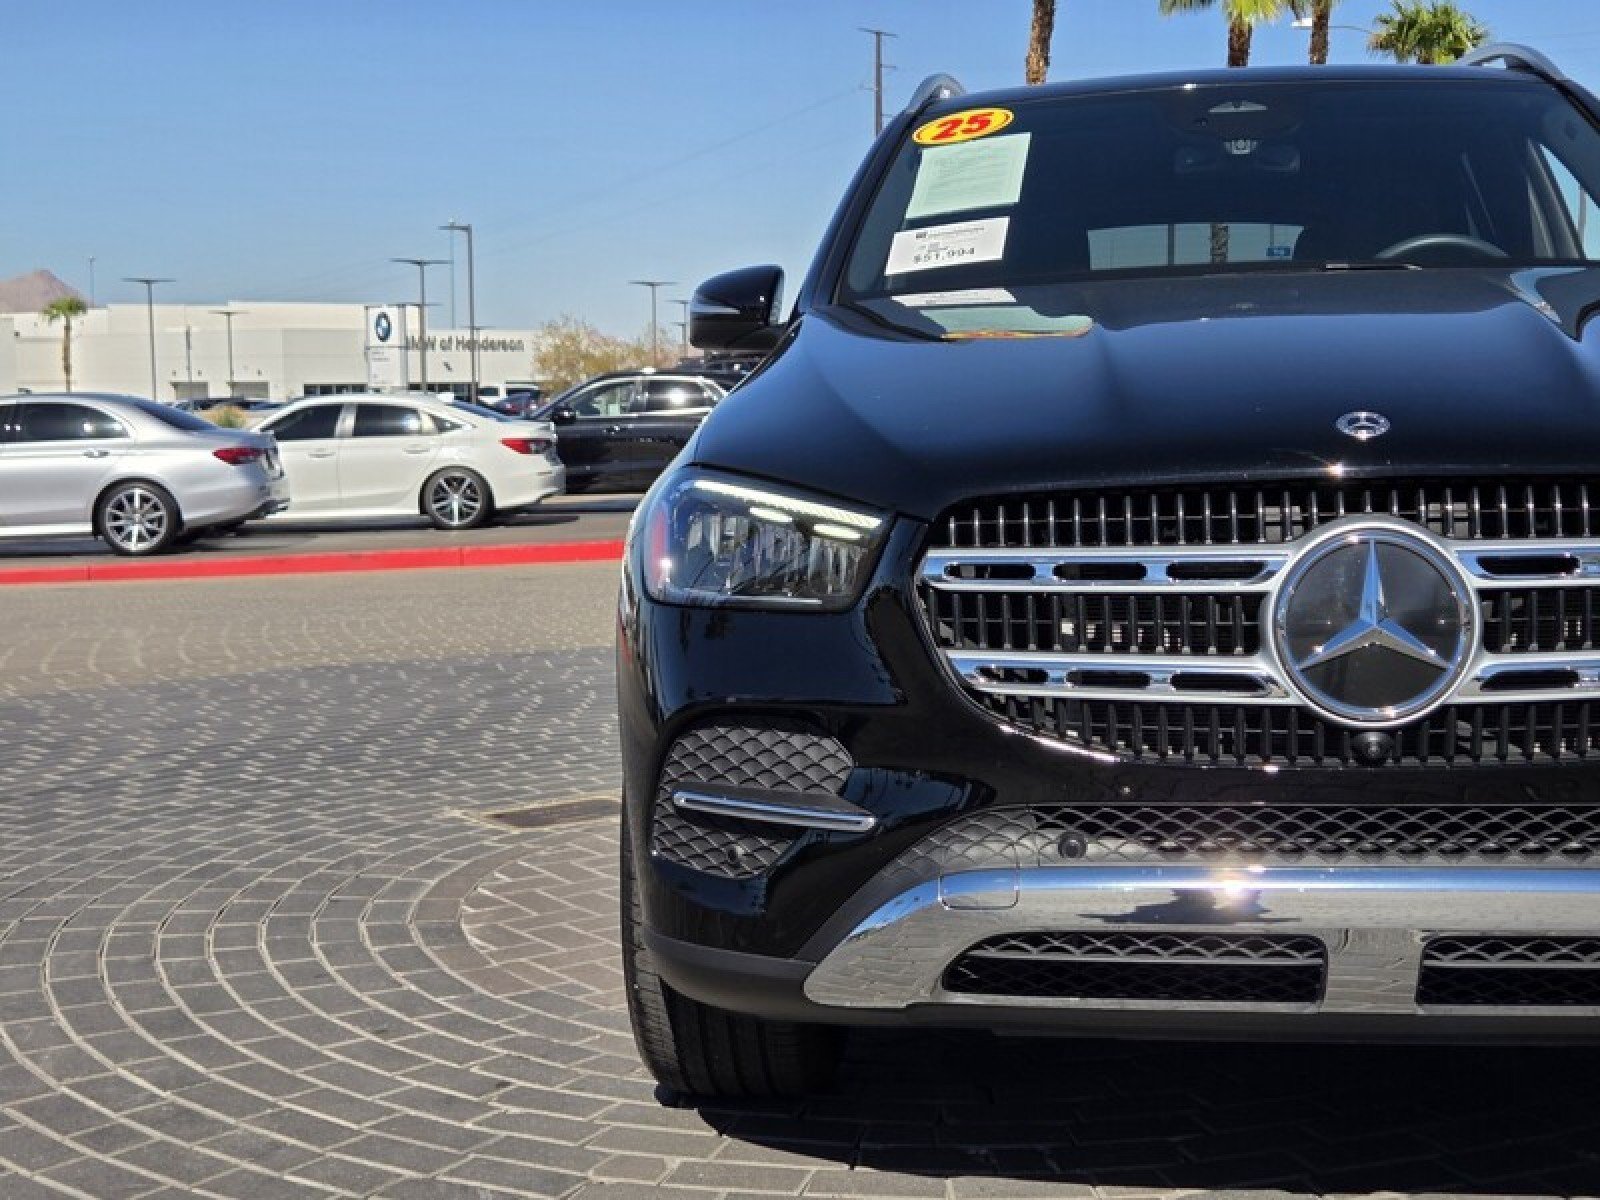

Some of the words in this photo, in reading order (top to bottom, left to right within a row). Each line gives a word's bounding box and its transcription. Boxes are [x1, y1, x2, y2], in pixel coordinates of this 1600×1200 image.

[930, 111, 995, 141] 25
[439, 335, 453, 352] of
[456, 335, 525, 352] Henderson
